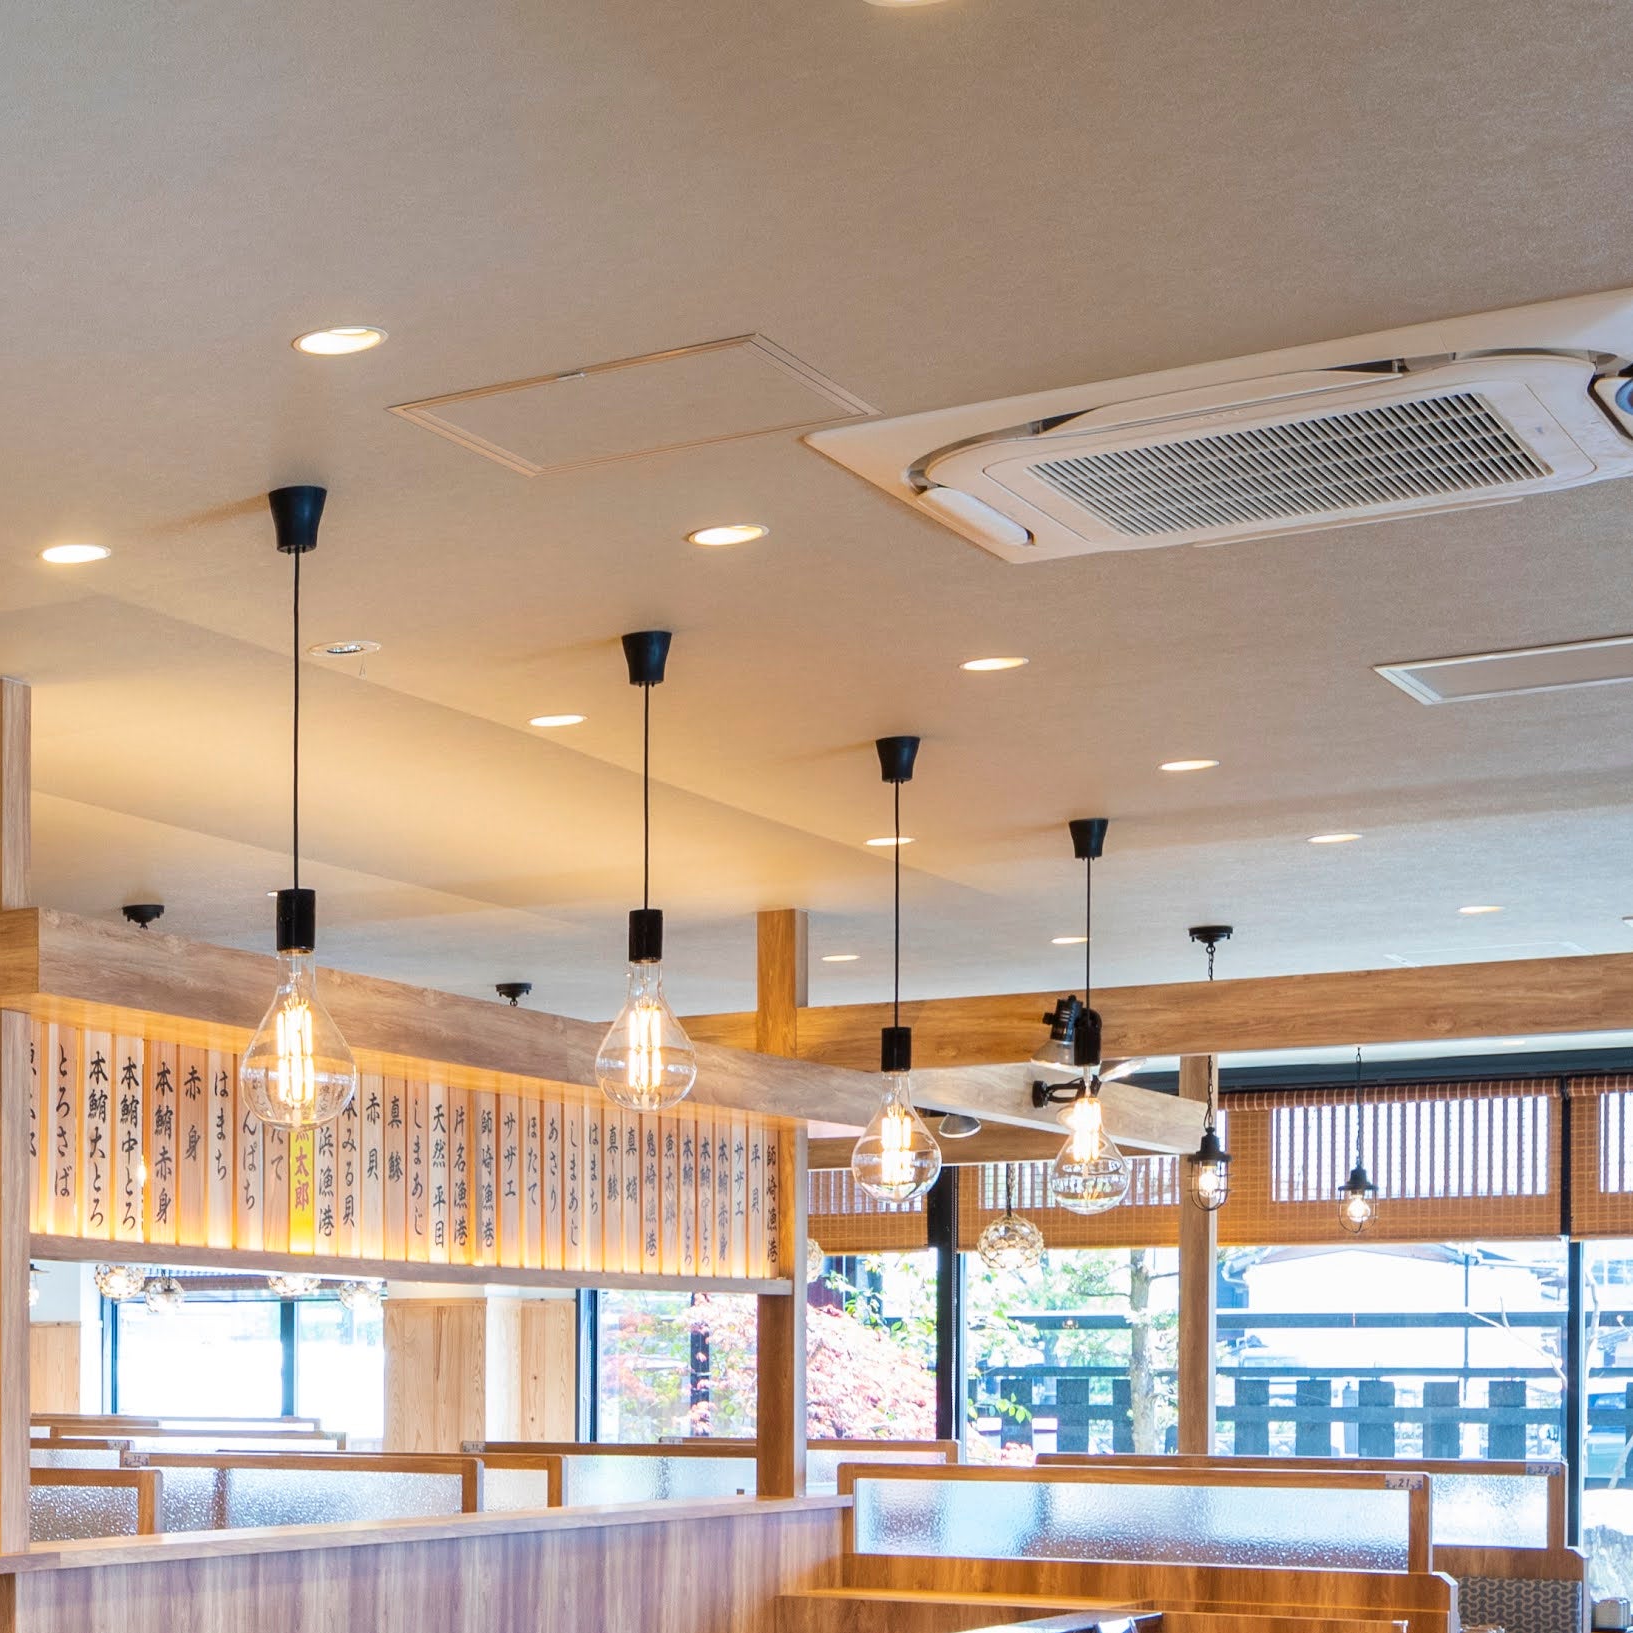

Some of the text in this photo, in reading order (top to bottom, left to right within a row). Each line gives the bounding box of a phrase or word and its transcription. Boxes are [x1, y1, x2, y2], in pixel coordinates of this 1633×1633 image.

[54, 1044, 73, 1197] とろさば
[88, 1051, 108, 1227] 本鮪大とろ
[120, 1056, 140, 1230] 本鮪中とろ
[154, 1061, 173, 1224] 本鮪赤身
[184, 1065, 202, 1162] 赤身
[214, 1070, 229, 1181] はまち
[365, 1092, 380, 1181] 赤貝
[504, 1112, 517, 1197] サザエ
[527, 1117, 538, 1205] ほたて
[411, 1100, 423, 1235] しまあじ
[453, 1106, 468, 1247] 片名漁港
[481, 1110, 494, 1247] 師崎漁港
[548, 1117, 559, 1213] あさり
[568, 1123, 578, 1246] しまあじ
[588, 1122, 599, 1215] はまち
[735, 1141, 744, 1216] サザエ
[750, 1144, 760, 1214] 平貝
[1398, 1478, 1410, 1488] 21
[1538, 1465, 1550, 1473] 22
